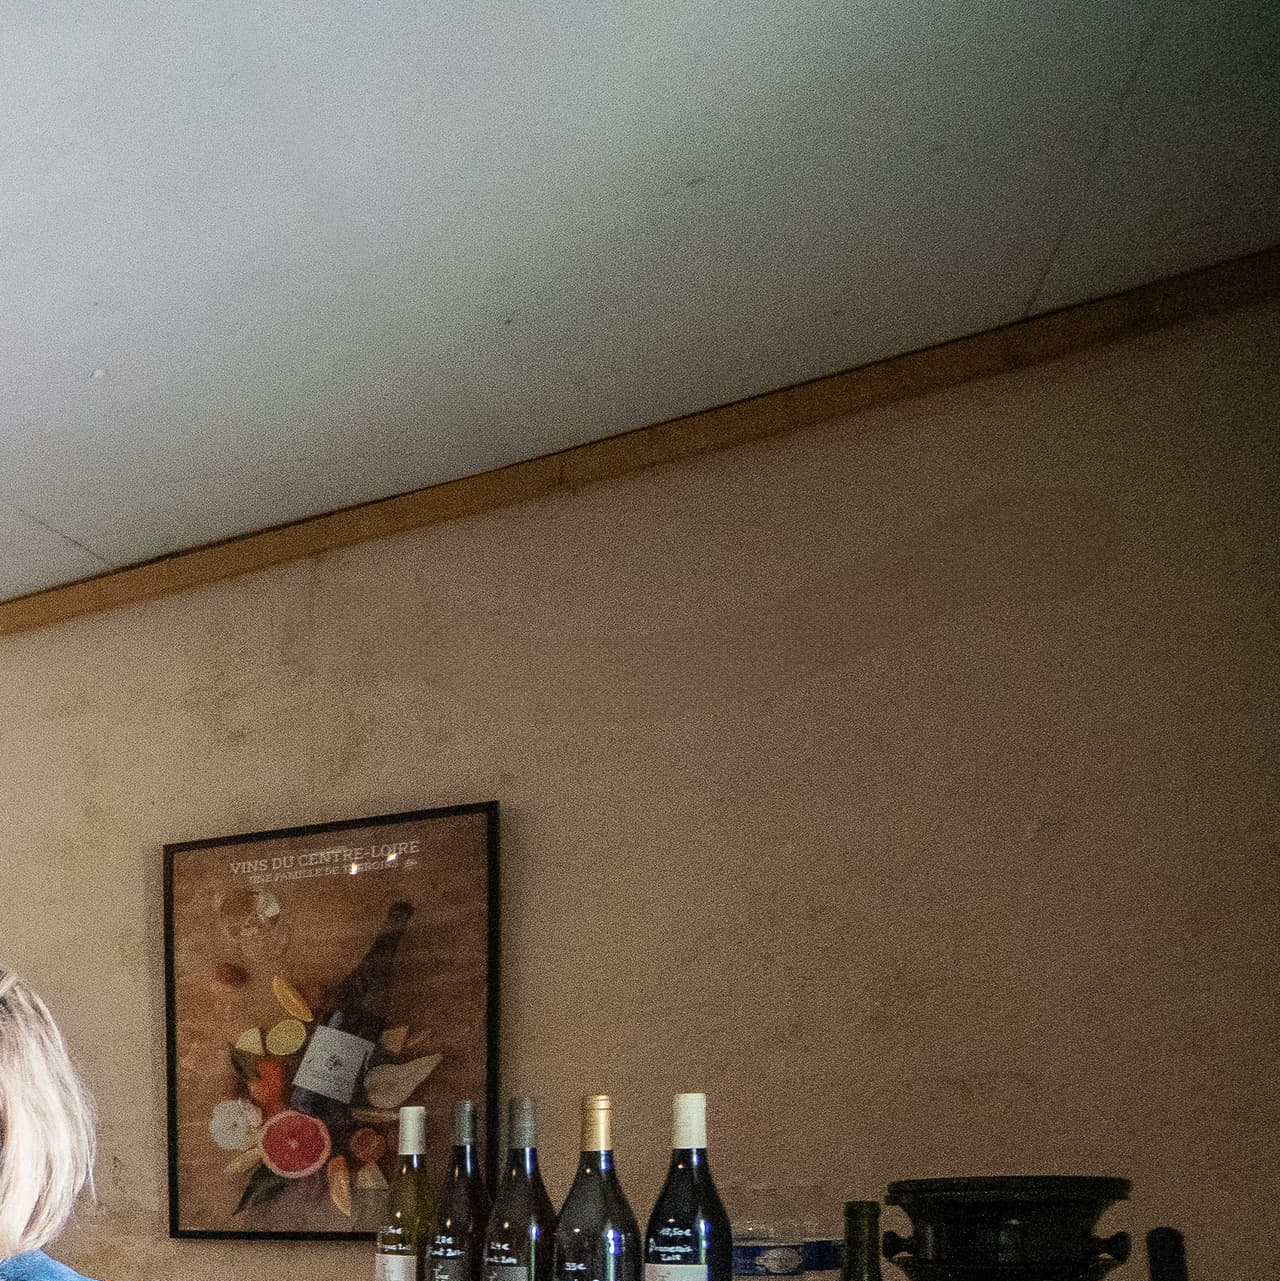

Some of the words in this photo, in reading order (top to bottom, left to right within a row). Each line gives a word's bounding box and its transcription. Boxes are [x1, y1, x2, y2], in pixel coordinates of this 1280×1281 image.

[230, 858, 268, 875] VINS
[272, 856, 296, 870] DU
[297, 840, 420, 867] CENTRE-LOIRE
